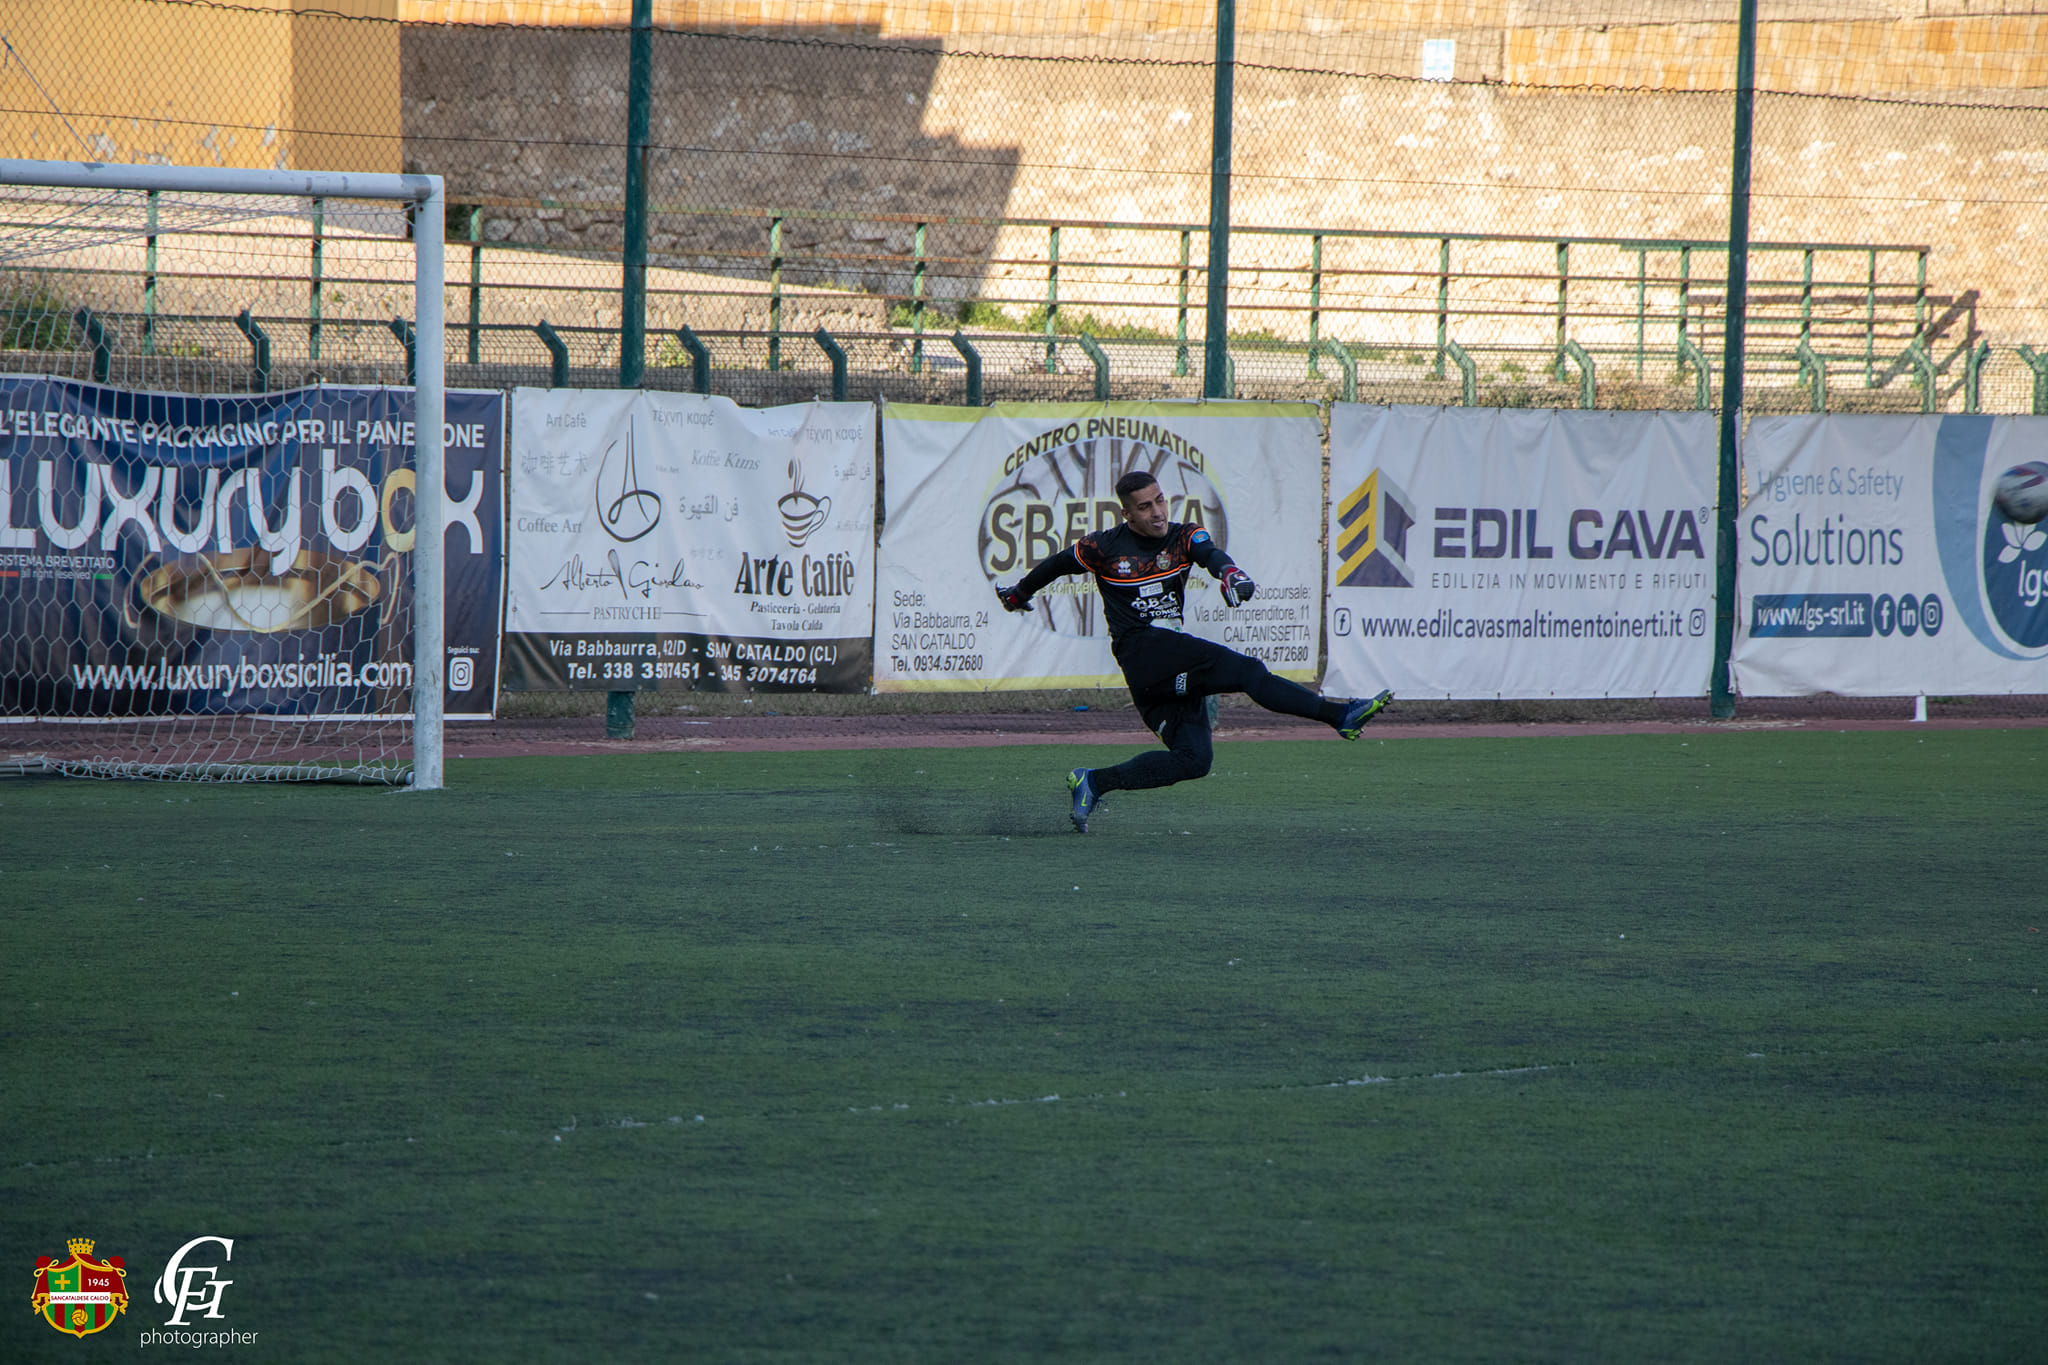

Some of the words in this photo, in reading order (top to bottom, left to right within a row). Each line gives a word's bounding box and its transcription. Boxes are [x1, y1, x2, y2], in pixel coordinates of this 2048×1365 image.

[0, 409, 137, 444] L'ELEGANTE
[142, 419, 278, 448] PACKAGING
[281, 419, 325, 444] PER
[332, 420, 351, 444] IL
[357, 421, 485, 448] PANEONE
[1003, 422, 1080, 476] CENTRO
[1087, 417, 1204, 473] PNEUMATICI
[1757, 469, 1825, 502] Hygiene
[1828, 466, 1843, 496] &
[1847, 467, 1904, 499] Safety
[517, 517, 558, 533] Coffee
[562, 518, 582, 534] Art
[1433, 507, 1554, 560] EDIL
[1750, 512, 1904, 567] Solutions
[45, 555, 116, 569] BREVETTATO
[734, 551, 794, 597] Arte
[801, 550, 855, 597] Caffè
[1431, 572, 1501, 589] EDILIZIA
[1510, 573, 1527, 589] IN
[1534, 573, 1627, 590] MOVIMENTO
[1634, 573, 1643, 589] E
[1652, 573, 1707, 589] RIFIUTI
[893, 590, 926, 607] Sede:
[1254, 584, 1312, 600] Succursale:
[750, 601, 800, 615] Pasticceria
[808, 602, 841, 615] Gelateria
[1194, 606, 1209, 622] Via
[1300, 604, 1310, 620] 11
[1756, 600, 1865, 631] www.lgs-srl.it
[771, 619, 799, 631] Tavola
[801, 619, 823, 631] Calda
[893, 611, 911, 629] Via
[914, 612, 973, 630] Babbaurra,
[975, 610, 989, 628] 24
[1362, 608, 1683, 639] www.edilcavasmaltimentoinerti.it
[891, 633, 917, 651] SAN
[920, 633, 976, 650] CATALDO
[1223, 625, 1311, 642] CALTANISSETTA
[550, 640, 572, 656] Via
[705, 642, 732, 659] SAN
[736, 643, 806, 662] CATALDO
[809, 645, 838, 666] (CL)
[891, 655, 911, 672] Tel.
[914, 654, 983, 671] 0934.572680
[73, 653, 412, 697] www.luxuryboxsicilia.com
[567, 662, 597, 679] Tel.
[603, 662, 634, 679] 338
[721, 665, 742, 682] 345
[746, 667, 817, 684] 3074764
